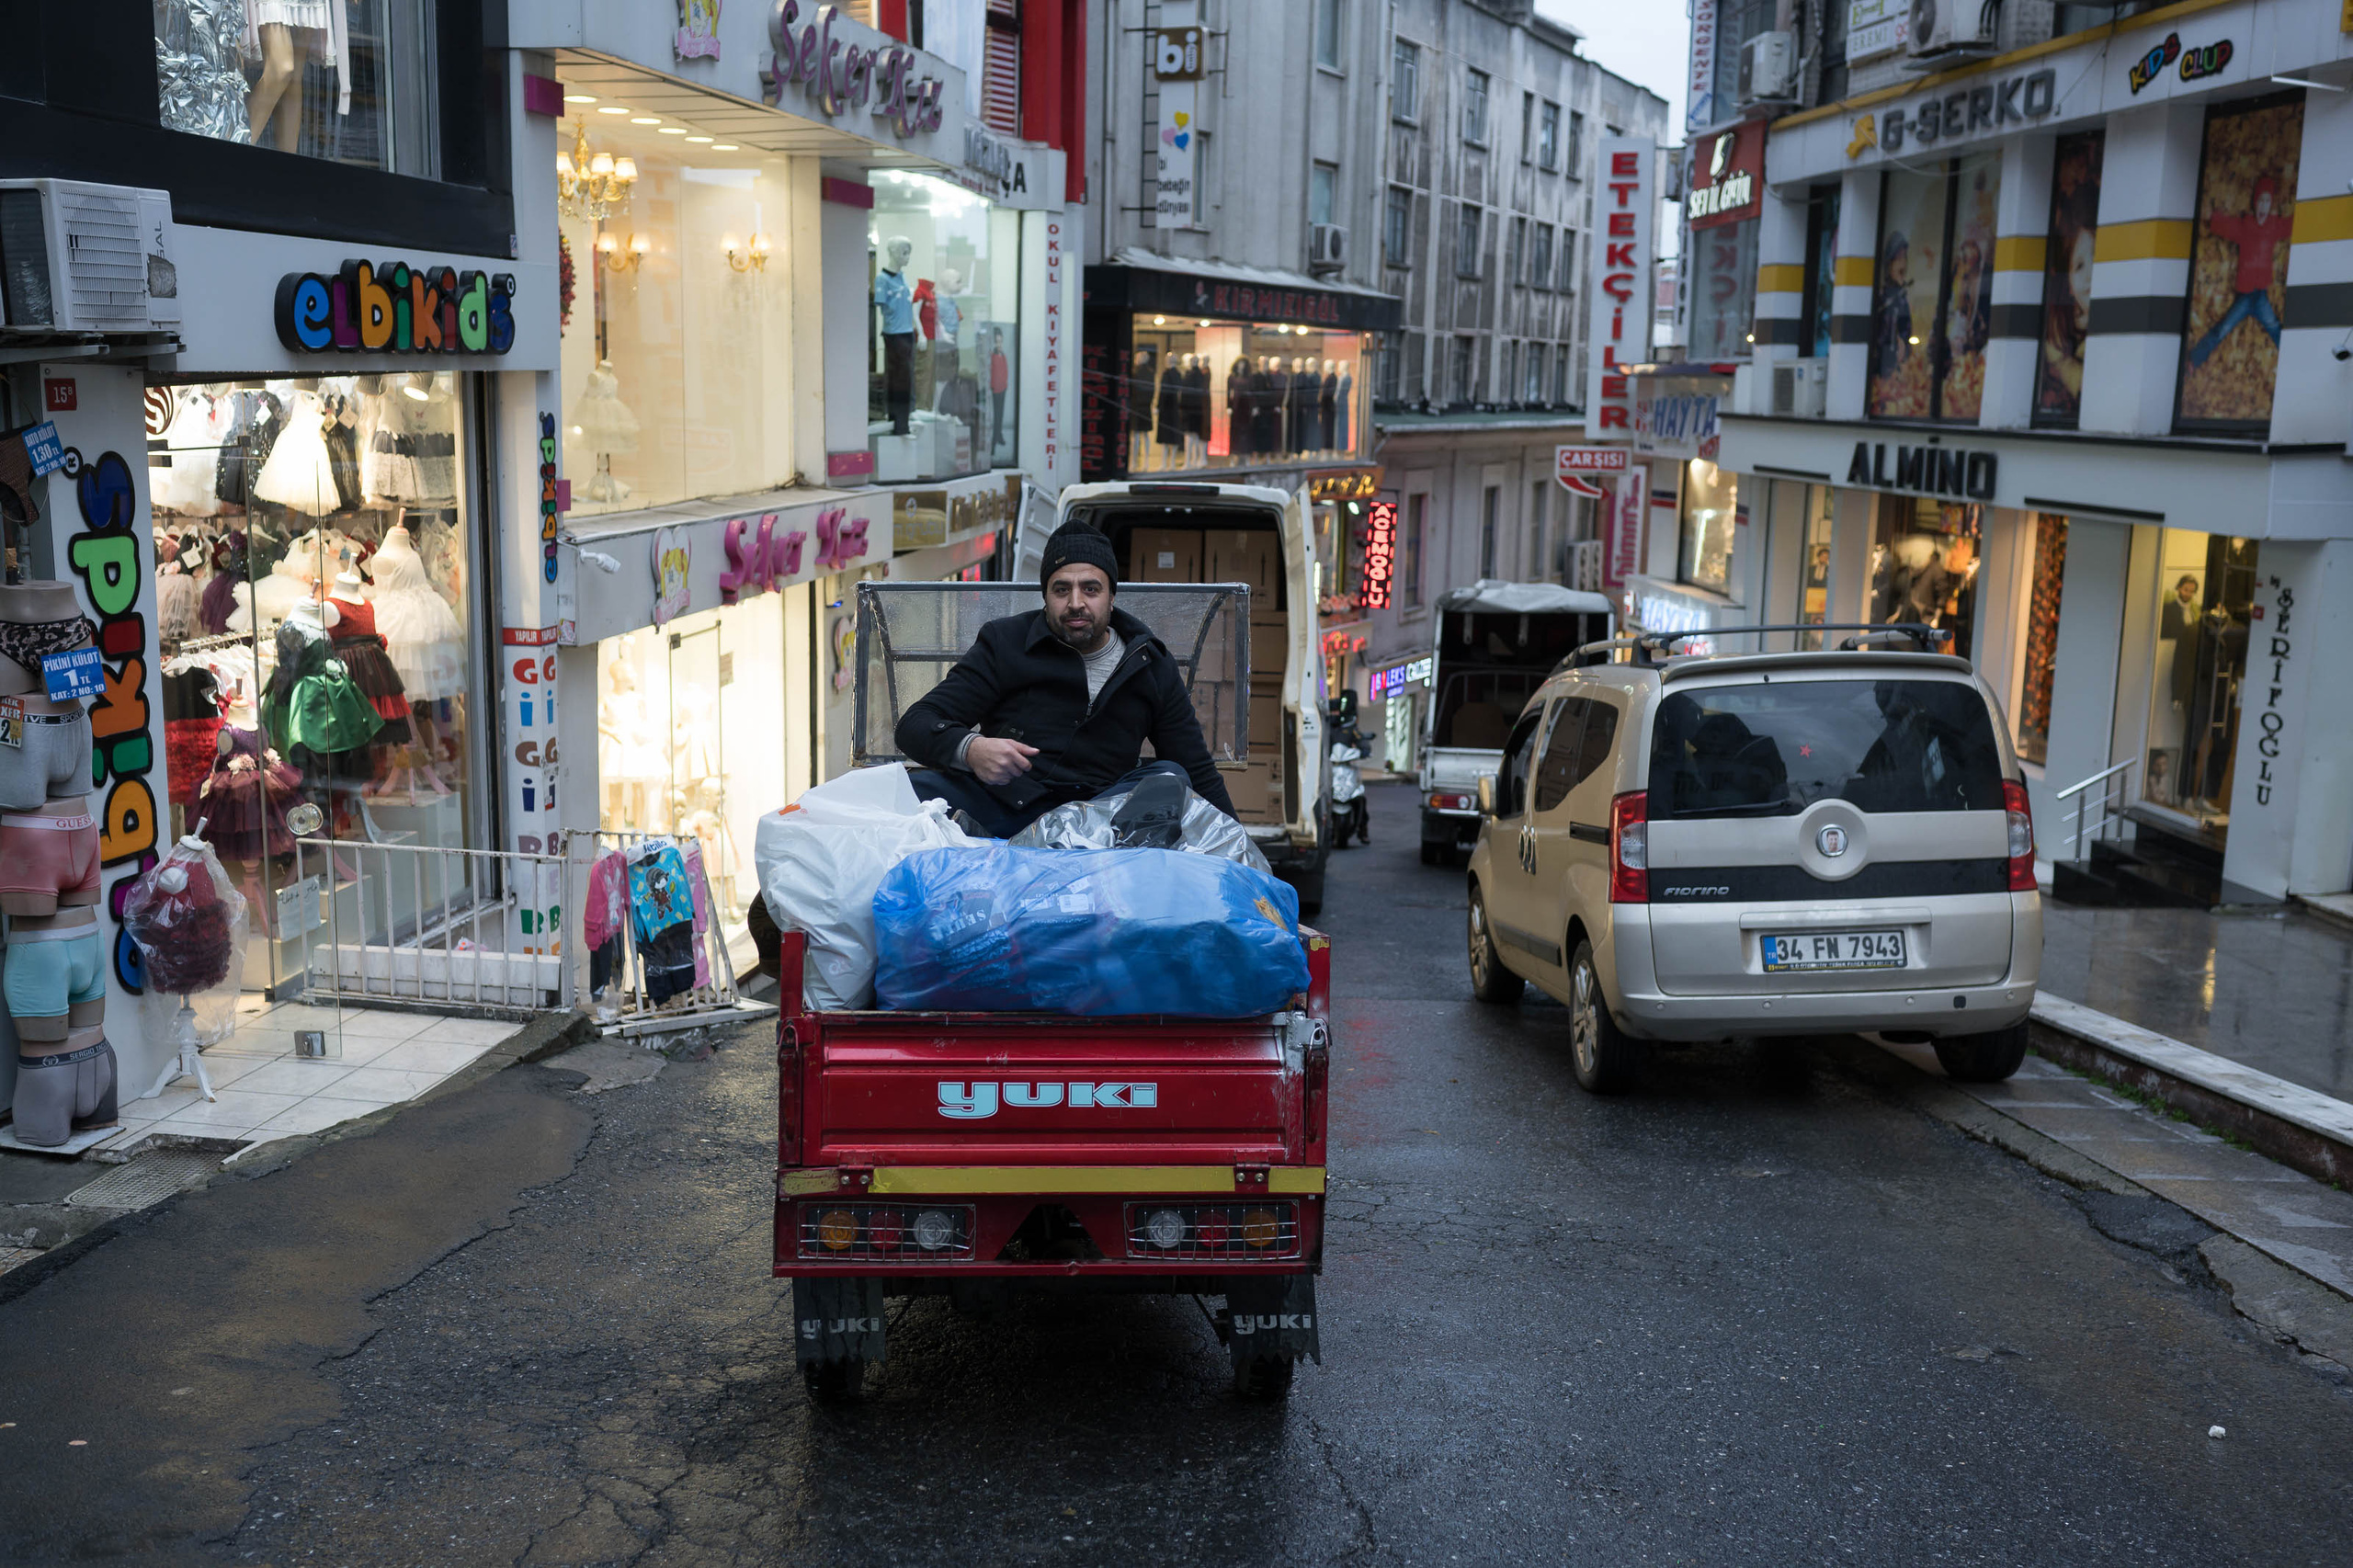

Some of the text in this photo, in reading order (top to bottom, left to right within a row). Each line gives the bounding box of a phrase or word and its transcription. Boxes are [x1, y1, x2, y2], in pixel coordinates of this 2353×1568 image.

[2130, 33, 2181, 96] KIDS
[1881, 68, 2056, 151] G-SERKO
[1599, 153, 1639, 428] ETEKÇİLER
[1046, 223, 1059, 471] OKUL KIYAFETLERİ
[1654, 396, 1717, 438] HAYTA
[1561, 451, 1624, 470] ÇARŞISI
[515, 630, 538, 642] YAPILIR
[43, 651, 98, 672] PİKİNİ KÜLOT
[63, 669, 91, 687] 1 TL
[51, 683, 105, 701] KAT: 2 NO: 10
[56, 813, 91, 828] GUESS
[1778, 935, 1901, 960] 34 FN 7943
